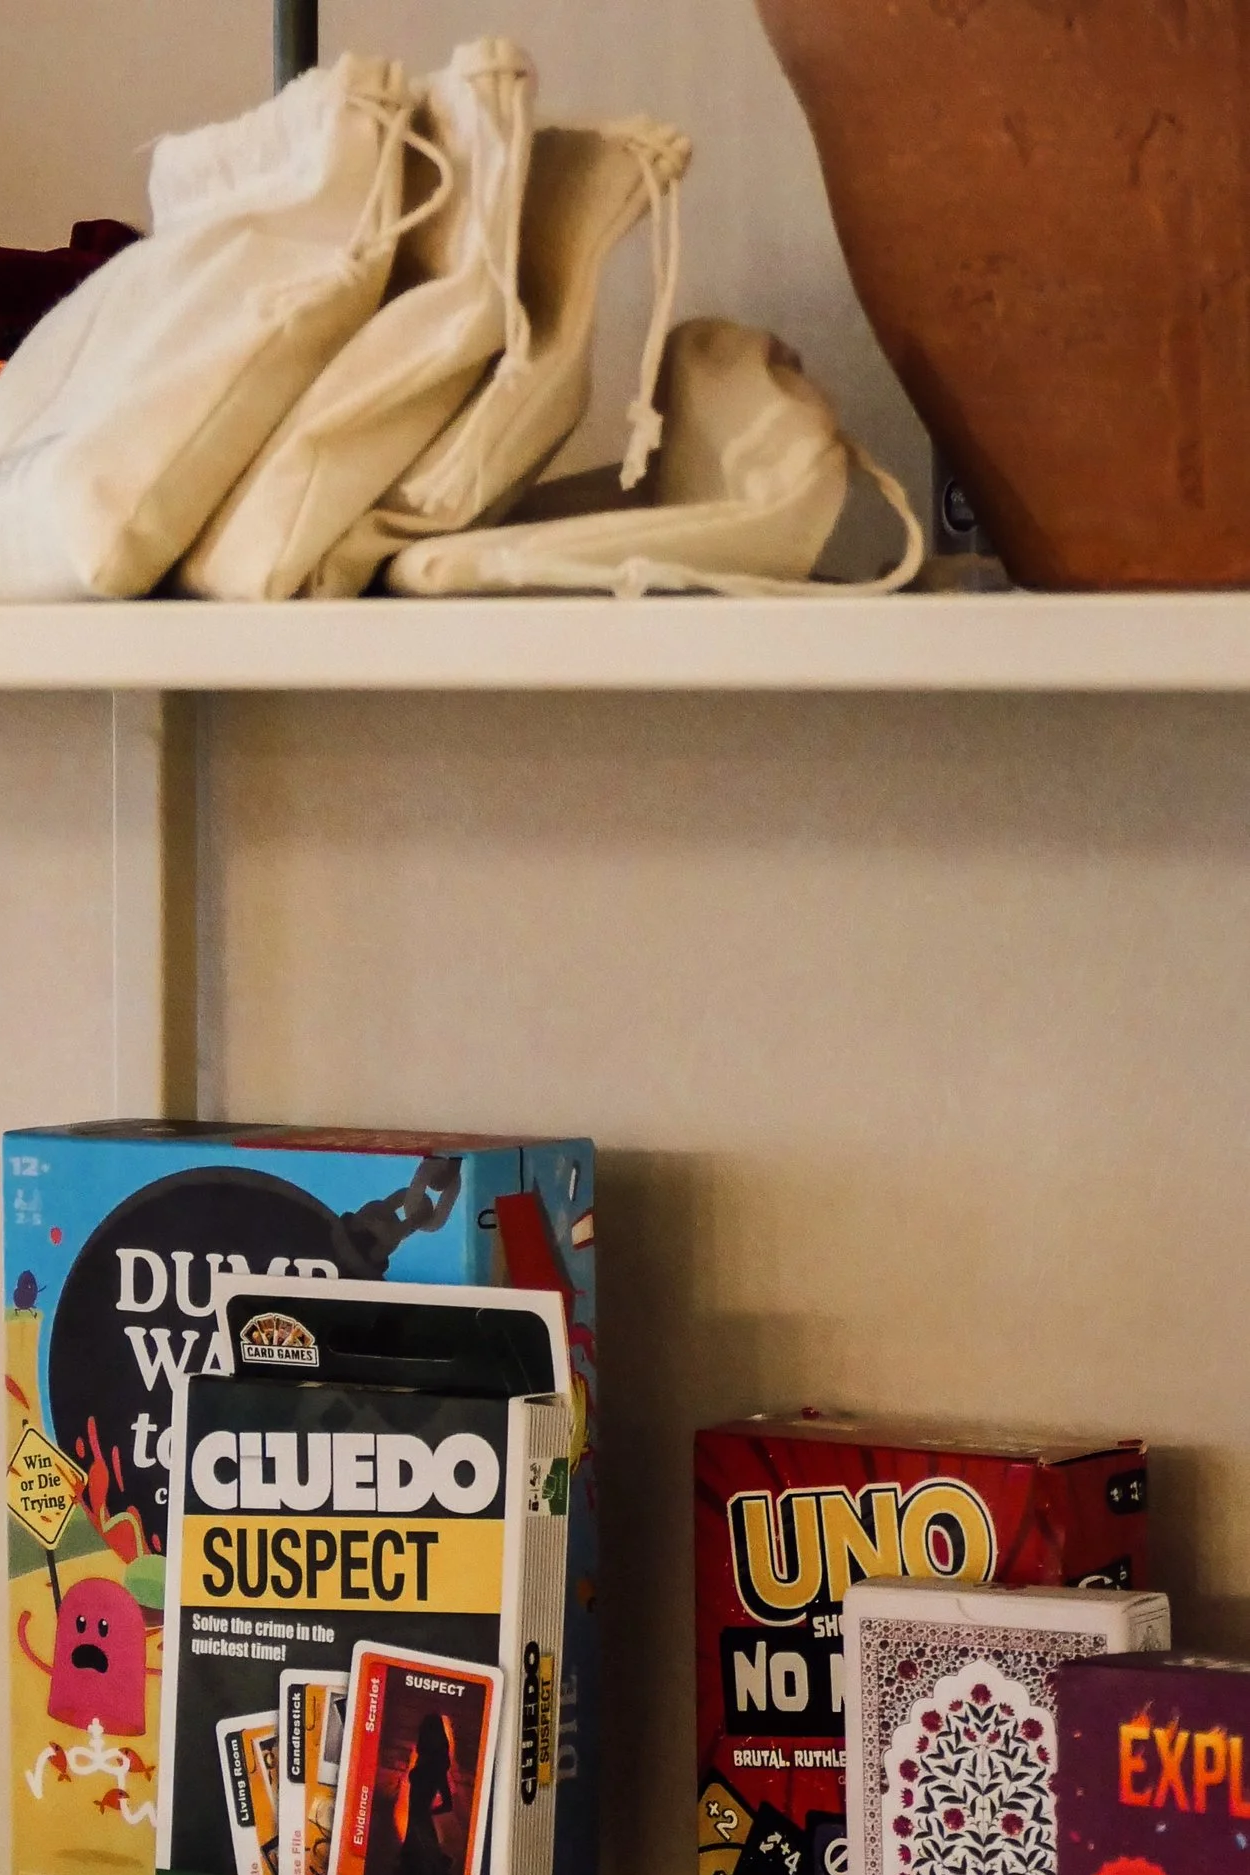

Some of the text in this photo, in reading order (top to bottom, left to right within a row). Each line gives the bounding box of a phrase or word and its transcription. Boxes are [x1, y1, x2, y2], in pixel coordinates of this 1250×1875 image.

[247, 1347, 313, 1361] CARD GAMES
[20, 1474, 62, 1492] or Die
[23, 1454, 53, 1470] Win
[191, 1431, 500, 1514] CLUEDO
[20, 1494, 66, 1513] Trying
[202, 1527, 439, 1602] SUSPECT
[728, 1478, 998, 1626] UNO
[191, 1637, 286, 1662] quickest time!
[192, 1613, 335, 1644] Solve the crime in the
[365, 1677, 380, 1733] Scarlet
[405, 1675, 465, 1697] SUSPECT
[733, 1641, 810, 1713] NO
[291, 1692, 301, 1777] Candlestick
[521, 1641, 540, 1804] CLUEDO
[539, 1678, 551, 1764] SUSPECT
[231, 1738, 250, 1822] Living Room
[733, 1747, 847, 1770] BRUTAL. RUTHLE
[291, 1829, 302, 1855] File
[353, 1785, 369, 1846] Evidence
